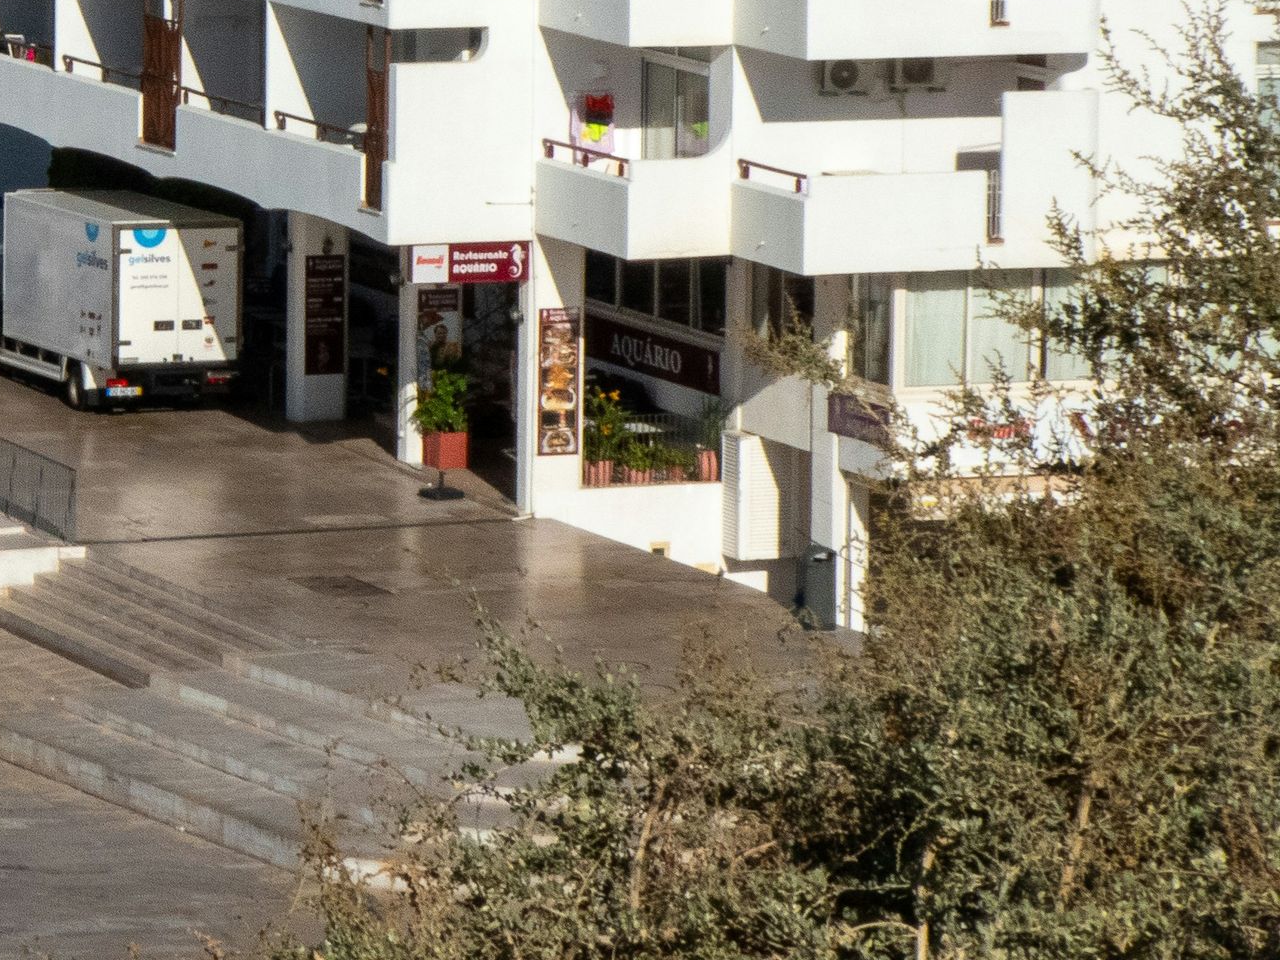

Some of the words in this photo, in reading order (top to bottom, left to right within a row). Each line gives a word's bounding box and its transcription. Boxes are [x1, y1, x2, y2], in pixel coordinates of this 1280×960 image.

[128, 253, 172, 266] gelsilves
[452, 250, 509, 261] Restaurante
[452, 261, 498, 274] AQUÁRIO
[610, 333, 683, 375] AQUÁRIO
